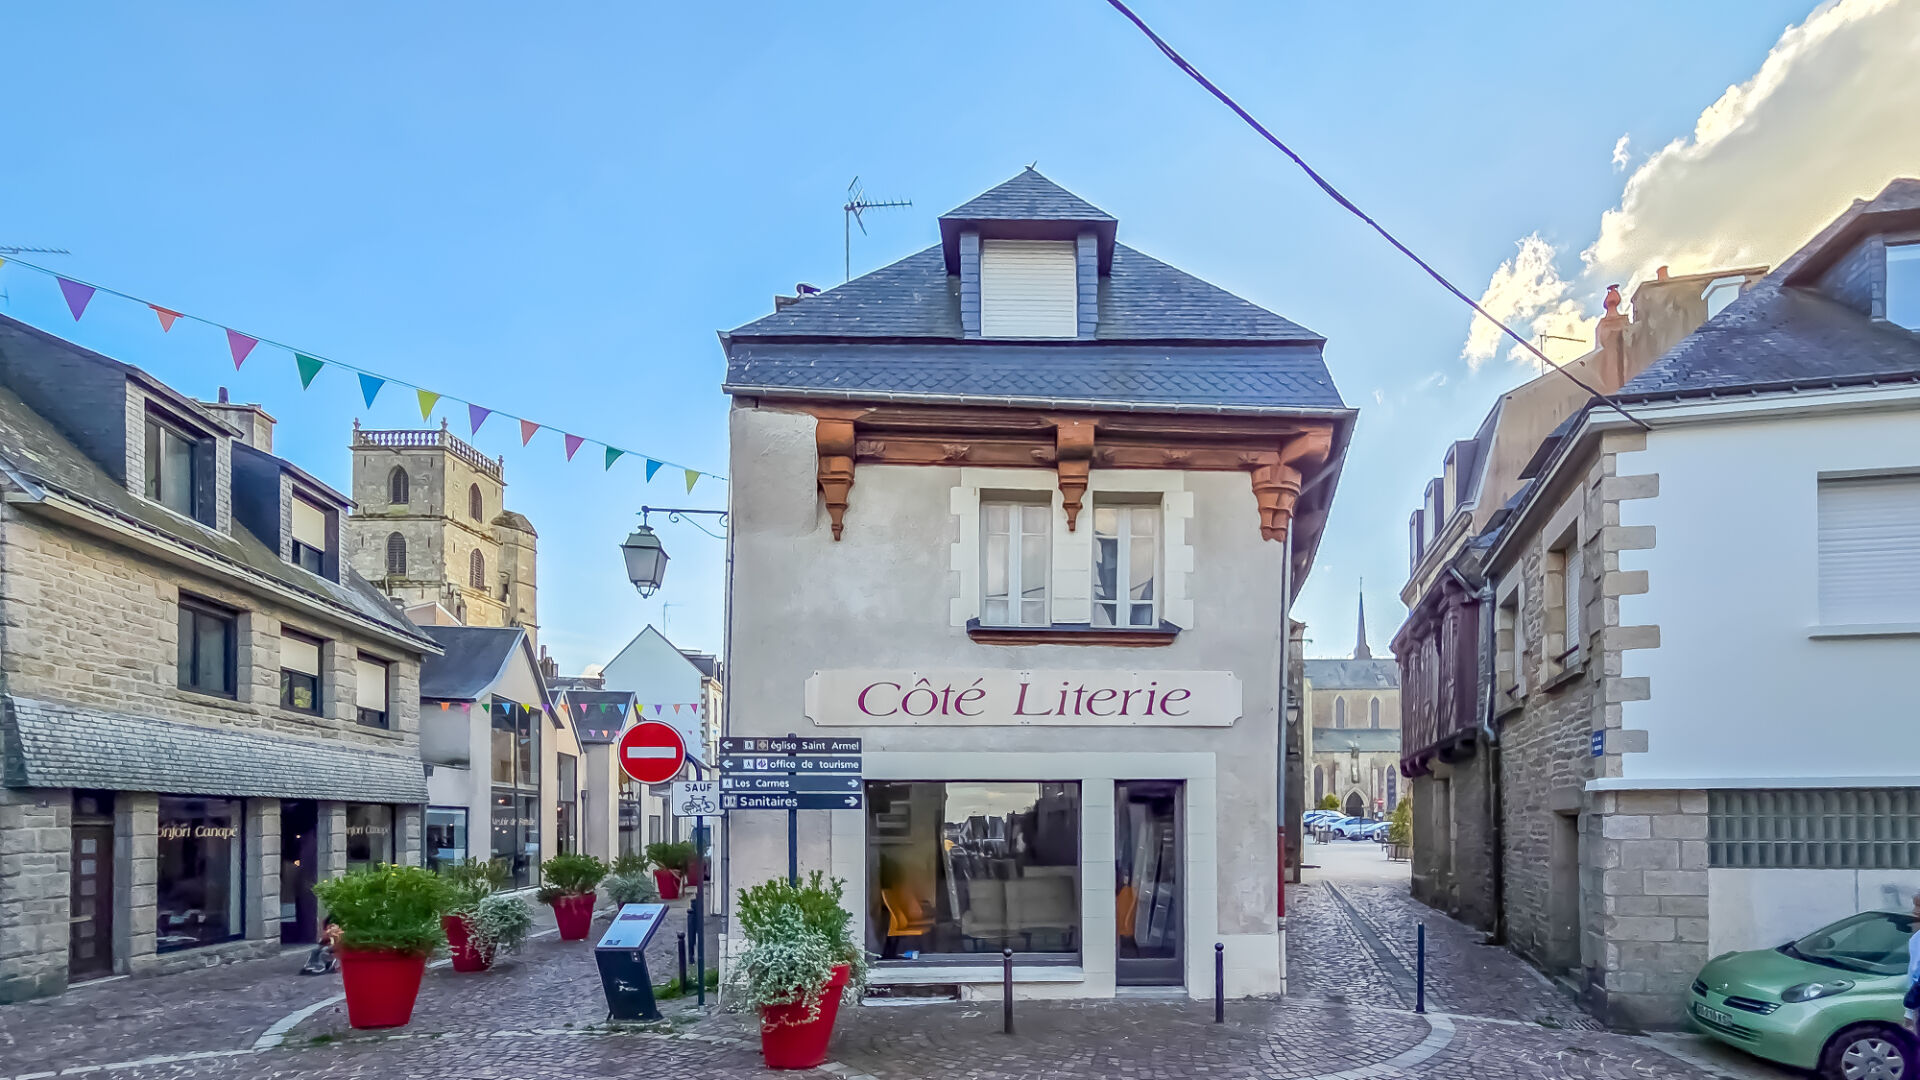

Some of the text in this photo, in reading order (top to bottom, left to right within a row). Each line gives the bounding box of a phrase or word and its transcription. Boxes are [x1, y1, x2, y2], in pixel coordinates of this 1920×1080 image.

[857, 677, 1191, 717] Côté Literie
[770, 740, 859, 752] église Saint Armel
[769, 759, 859, 769] office de tourisme
[684, 783, 712, 792] SAUF
[735, 779, 790, 788] Les Carmes
[740, 796, 798, 807] Sanitaires
[157, 823, 238, 841] onfort Canapé
